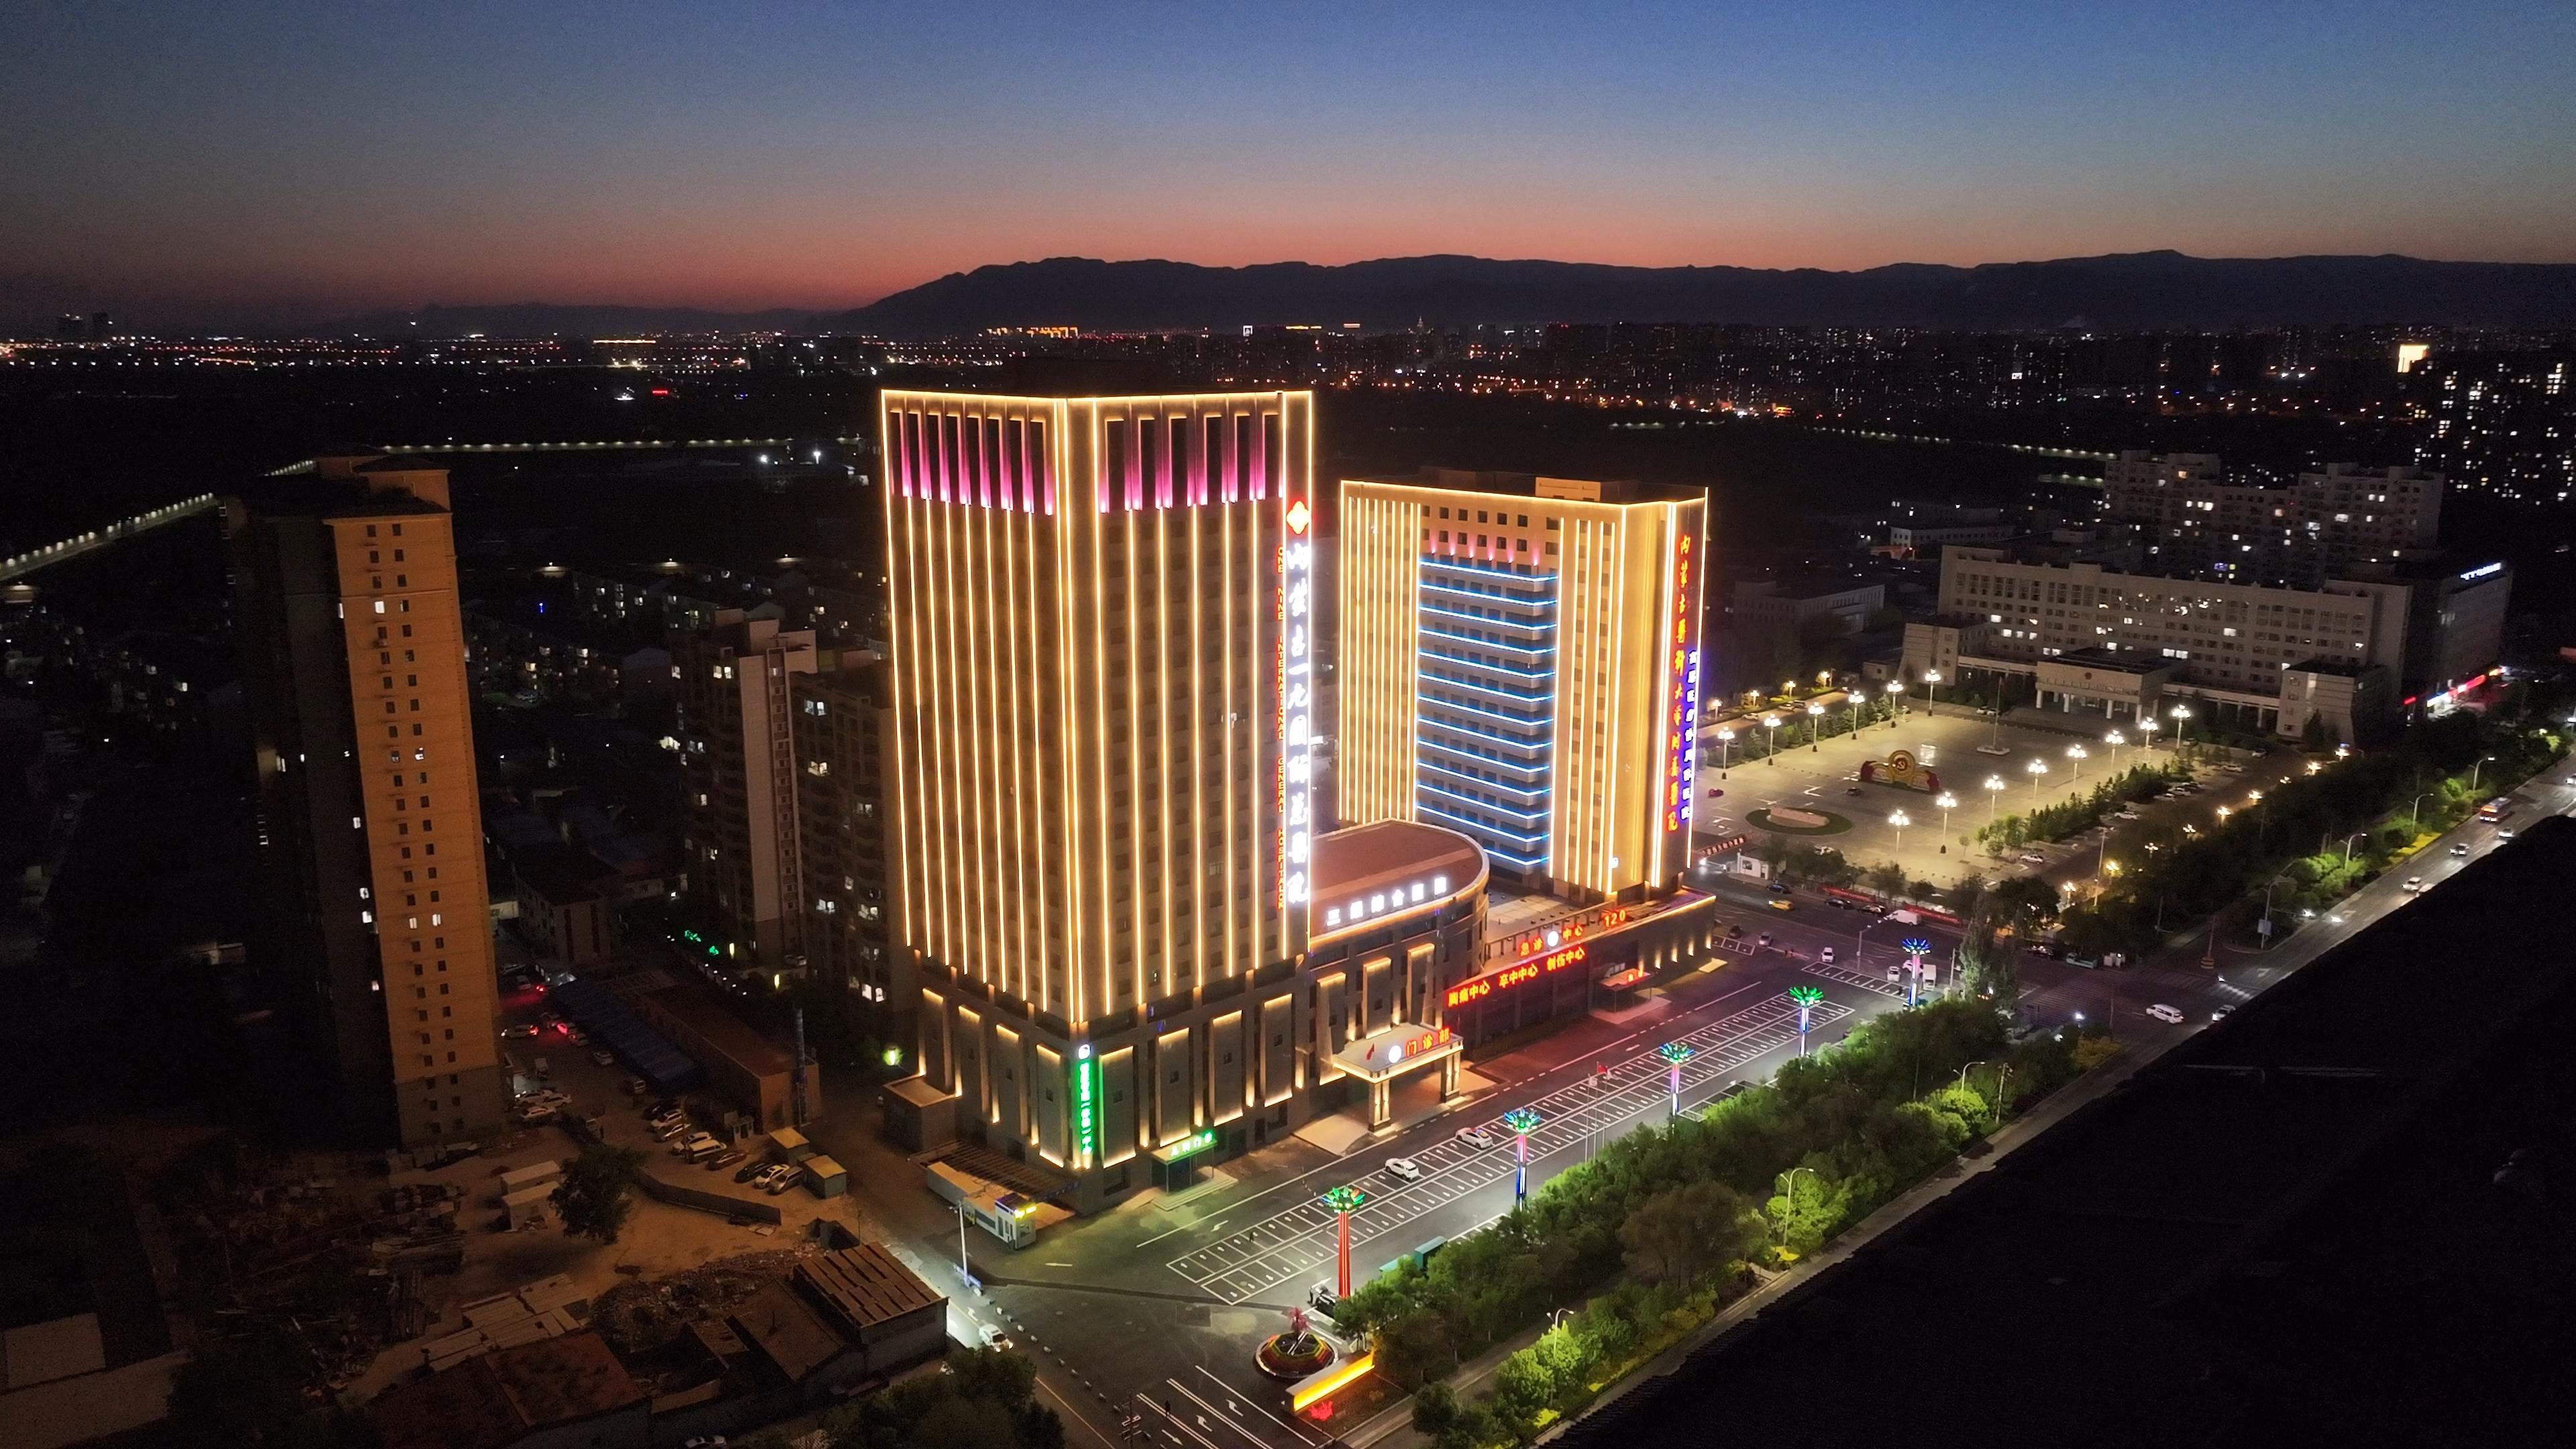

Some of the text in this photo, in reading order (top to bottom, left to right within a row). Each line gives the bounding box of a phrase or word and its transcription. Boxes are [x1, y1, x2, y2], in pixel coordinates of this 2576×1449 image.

[1604, 910, 1626, 928] 120
[1406, 1028, 1450, 1058] 门诊部
